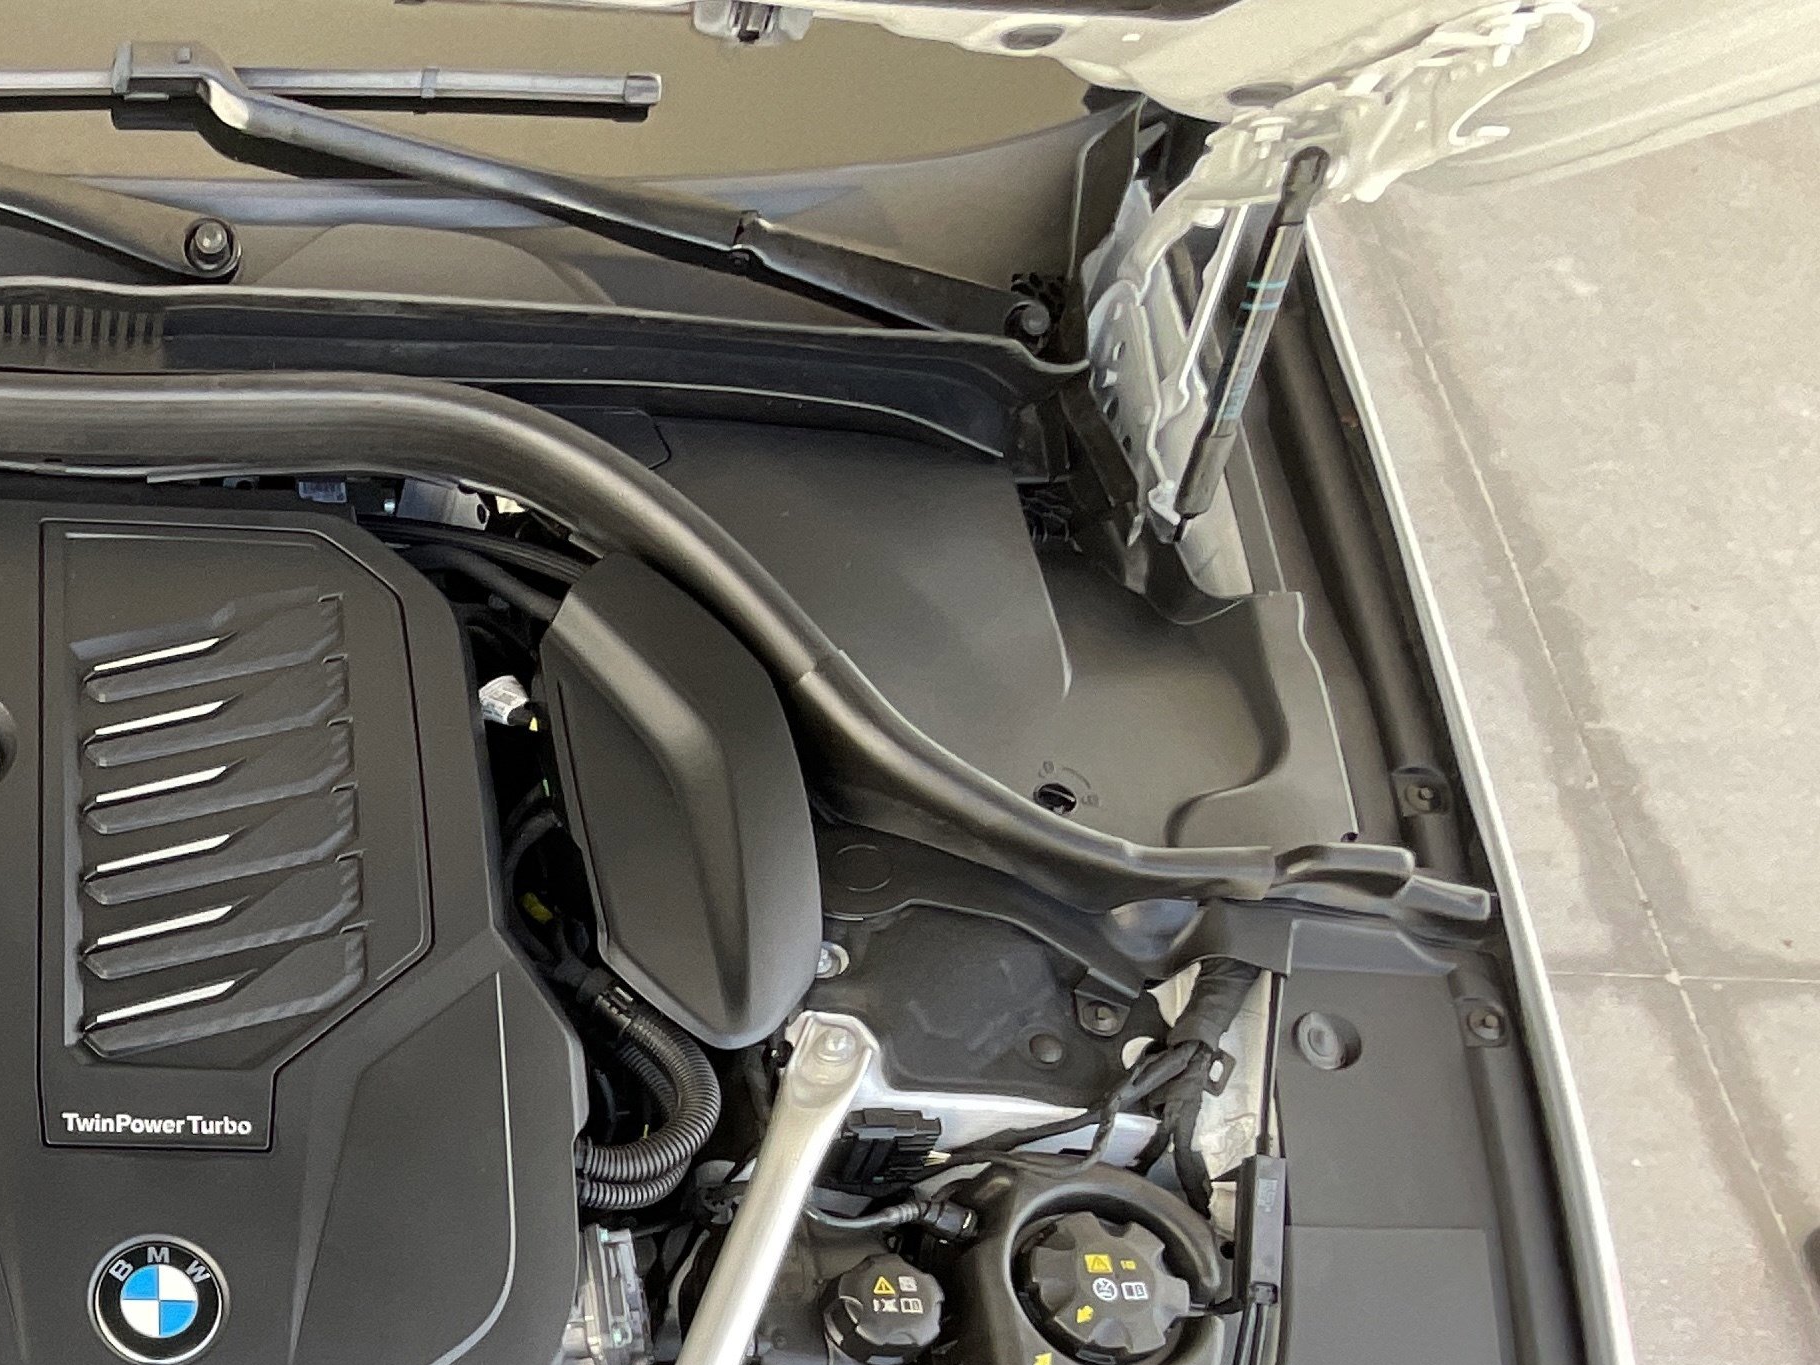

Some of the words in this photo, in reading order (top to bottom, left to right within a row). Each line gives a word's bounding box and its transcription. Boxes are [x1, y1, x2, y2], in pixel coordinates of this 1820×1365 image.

[61, 1112, 185, 1134] TwinPower
[186, 1115, 252, 1135] Turbo
[108, 1246, 211, 1283] BMW
